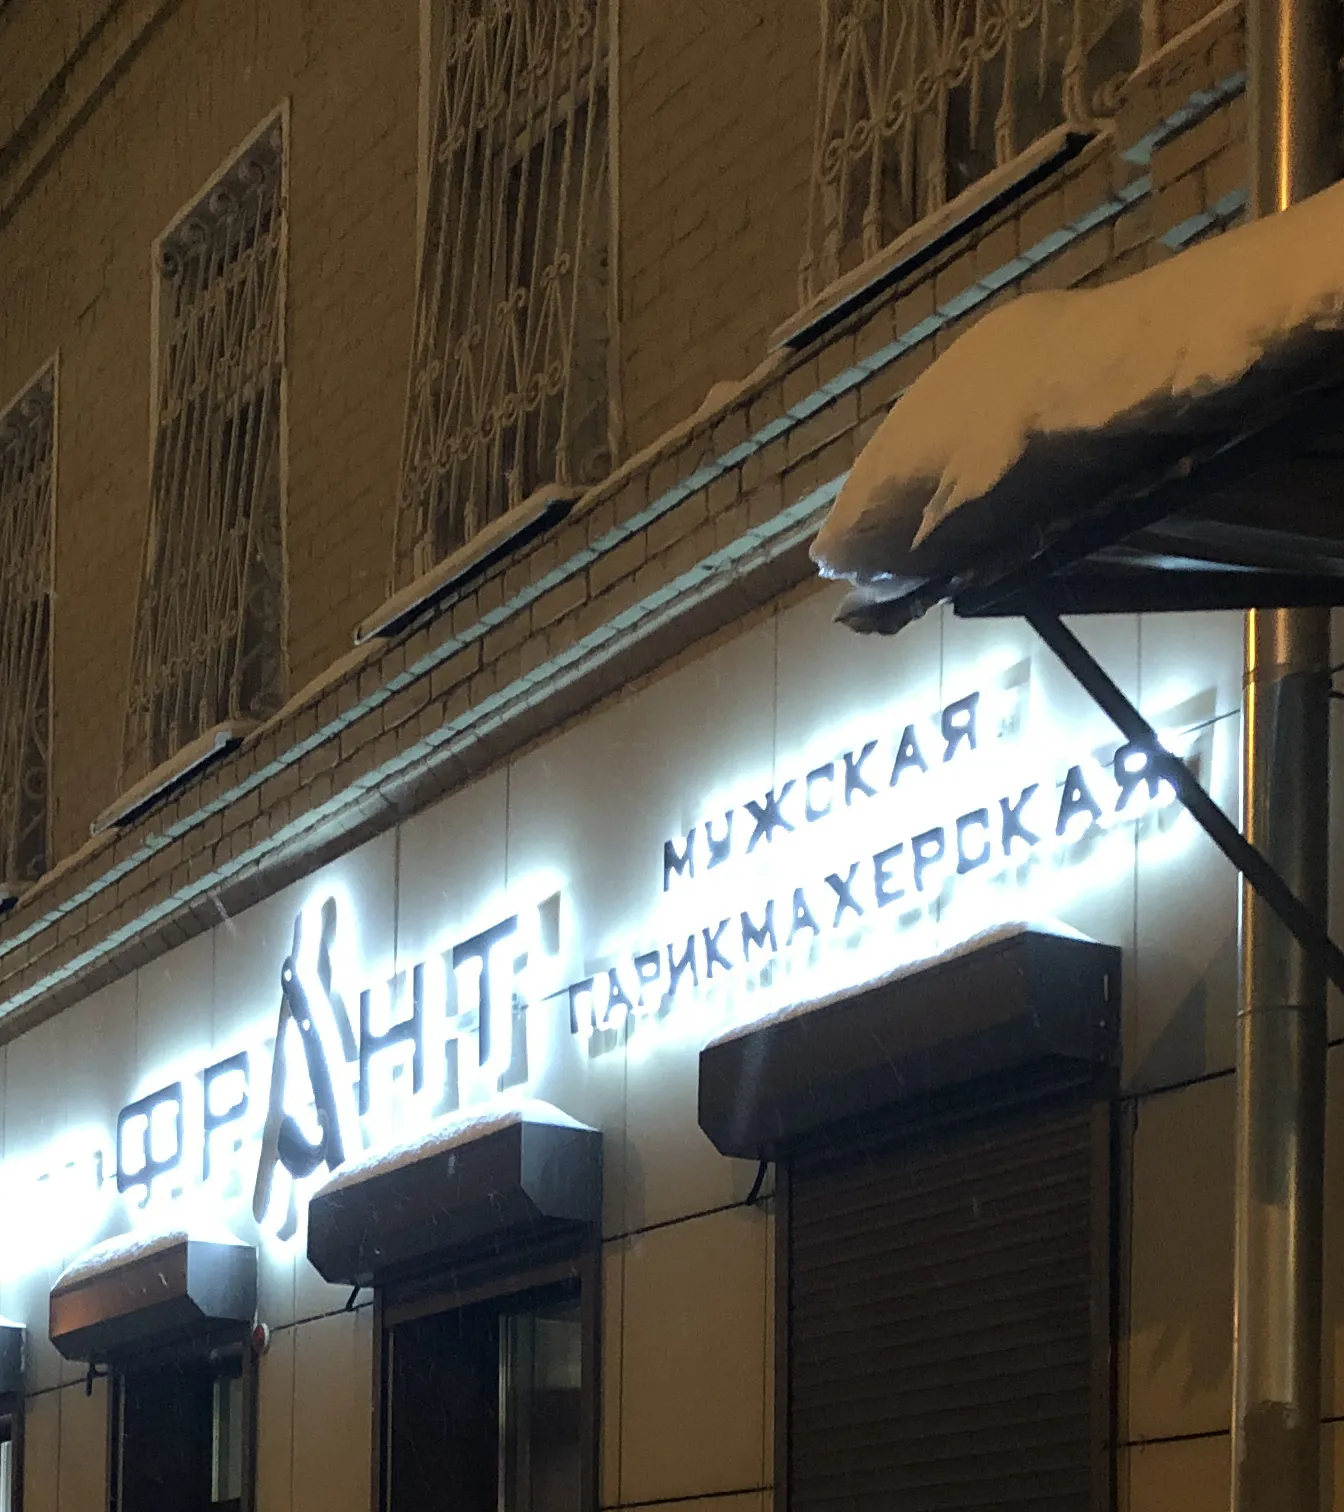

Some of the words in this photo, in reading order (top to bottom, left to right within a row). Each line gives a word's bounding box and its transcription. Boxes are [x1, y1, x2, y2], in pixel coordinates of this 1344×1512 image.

[568, 738, 1160, 1035] ПАРИКМАХЕРСКАЯ
[663, 692, 980, 892] МУЖСКАЯ
[117, 908, 519, 1224] ФРАНТ
